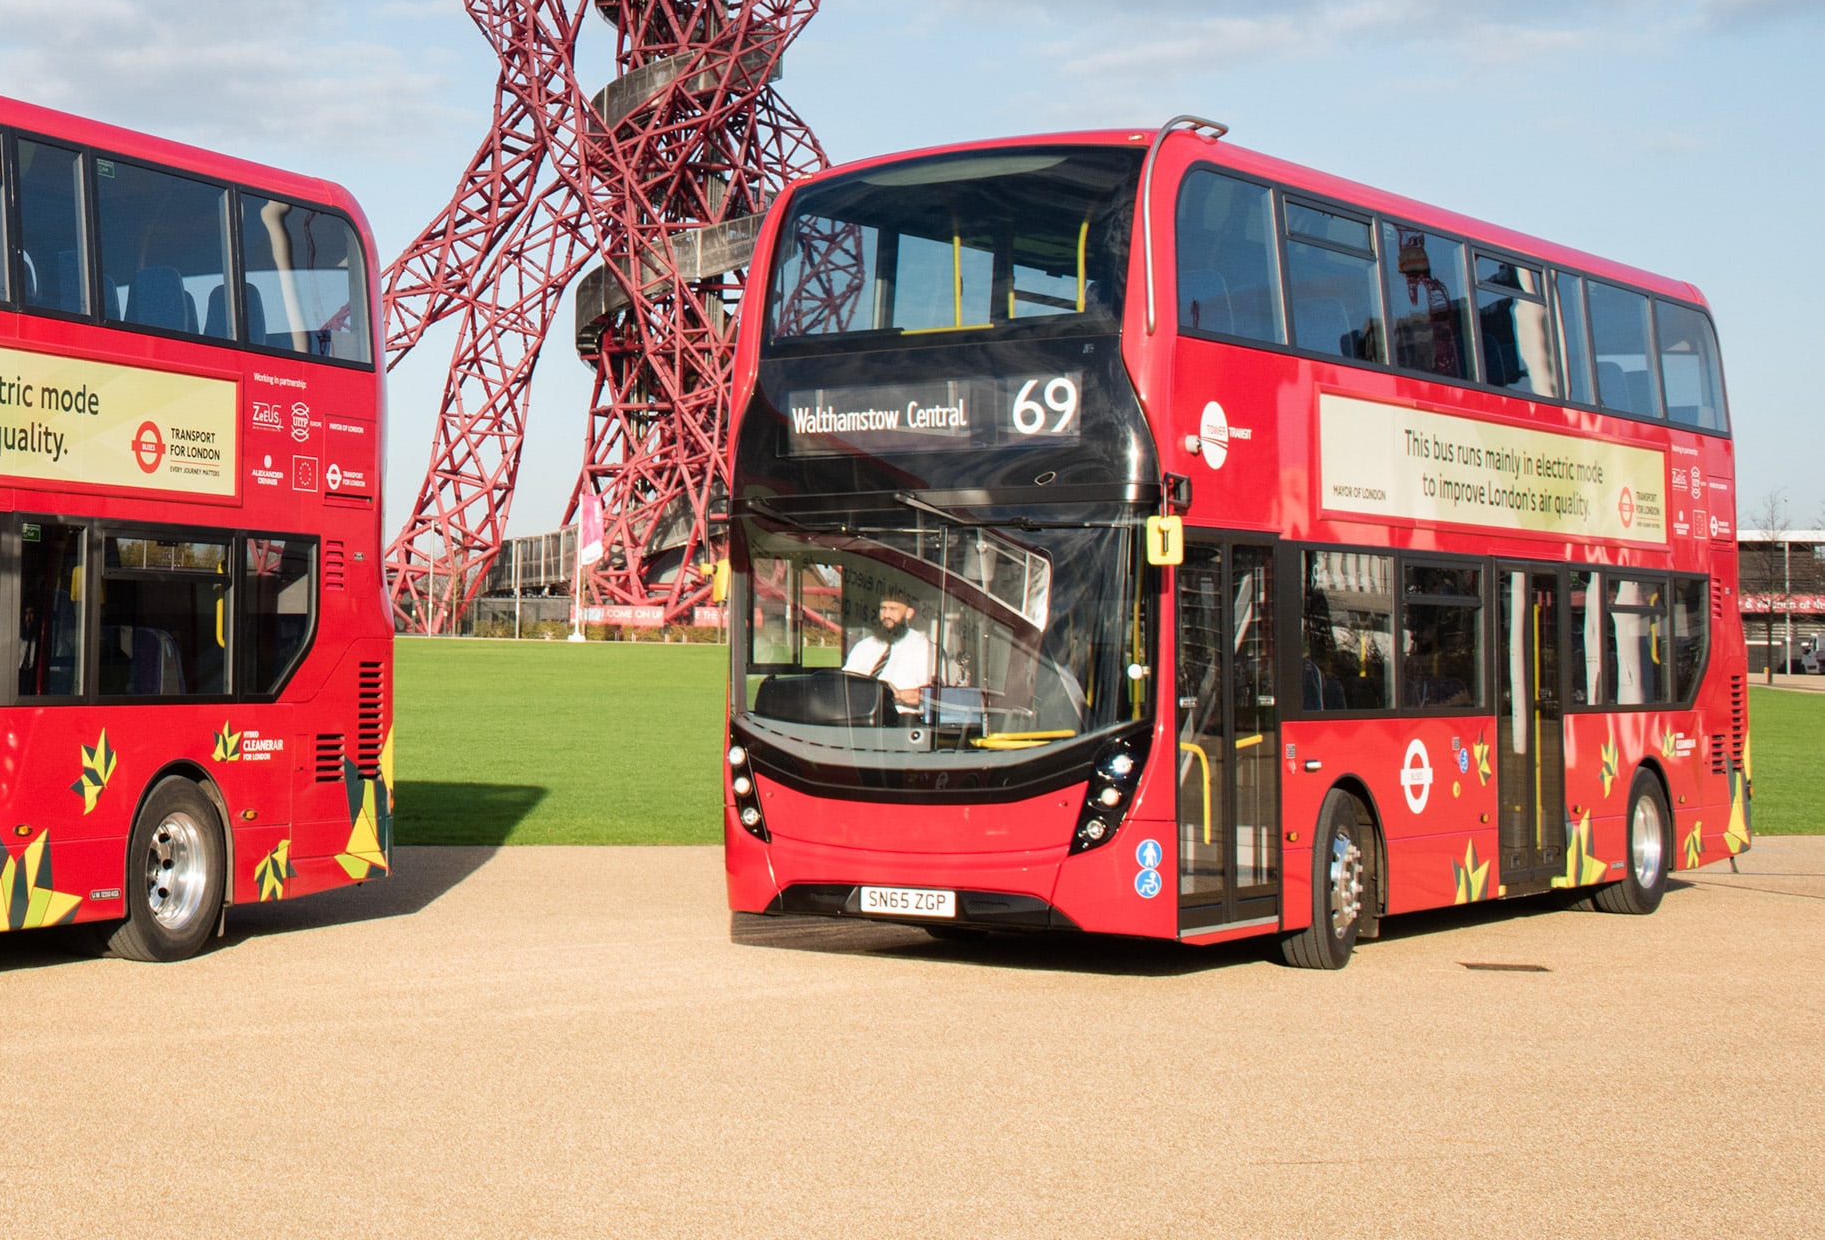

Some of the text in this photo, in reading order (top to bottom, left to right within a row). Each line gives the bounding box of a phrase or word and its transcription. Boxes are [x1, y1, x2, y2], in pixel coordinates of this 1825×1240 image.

[40, 384, 100, 416] mode
[792, 377, 1077, 435] Walthamstow Central 69
[171, 427, 216, 444] TRANSPORT
[170, 444, 220, 461] FOR LONDON
[1405, 429, 1604, 484] This bus runs mainly in electric mode
[1423, 472, 1591, 522] to improve London's air quality.
[607, 608, 633, 619] COME
[635, 608, 650, 619] ON
[869, 890, 946, 911] SN65 ZGP
